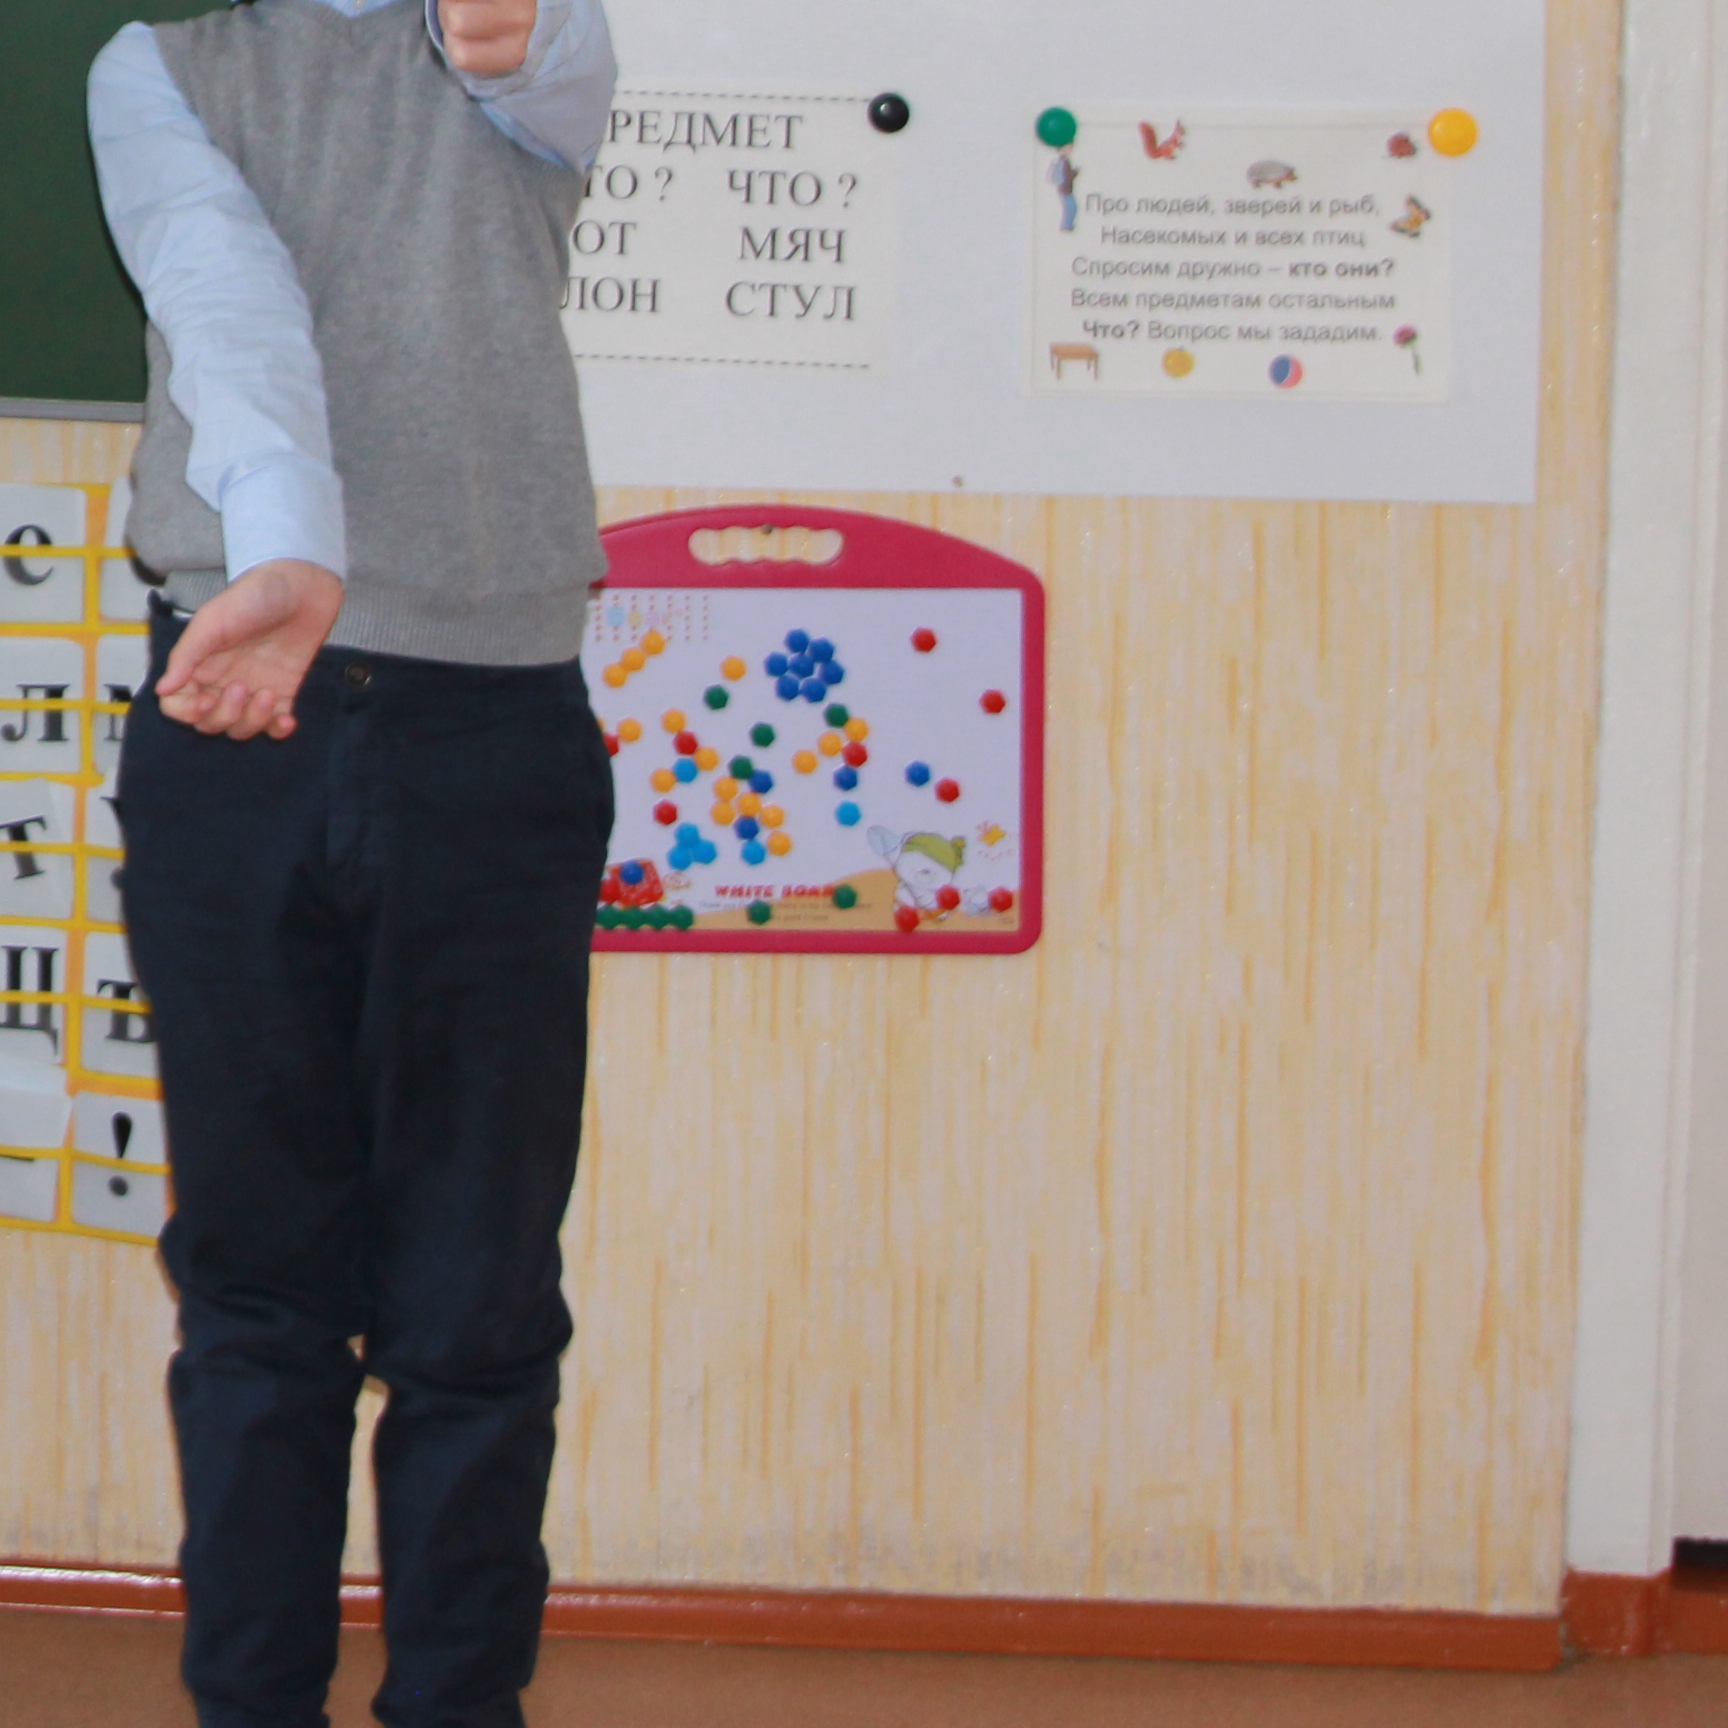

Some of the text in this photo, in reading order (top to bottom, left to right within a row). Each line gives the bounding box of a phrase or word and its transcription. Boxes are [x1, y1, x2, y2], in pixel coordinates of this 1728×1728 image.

[609, 110, 803, 153] РЕДМЕТ
[727, 170, 822, 206] ЧТО
[1085, 194, 1379, 217] Про людей, зверей и рыб,
[572, 220, 845, 263] ОТ МЯЧ
[1100, 227, 1364, 246] Насекомых и всех птиц
[1071, 258, 1394, 279] Спросим дружно кто они?
[558, 276, 856, 320] ЛОН СТУЛ
[1071, 289, 1395, 312] Всем предметам остальным
[1083, 320, 1382, 343] Что? Вопрос мы зададим.
